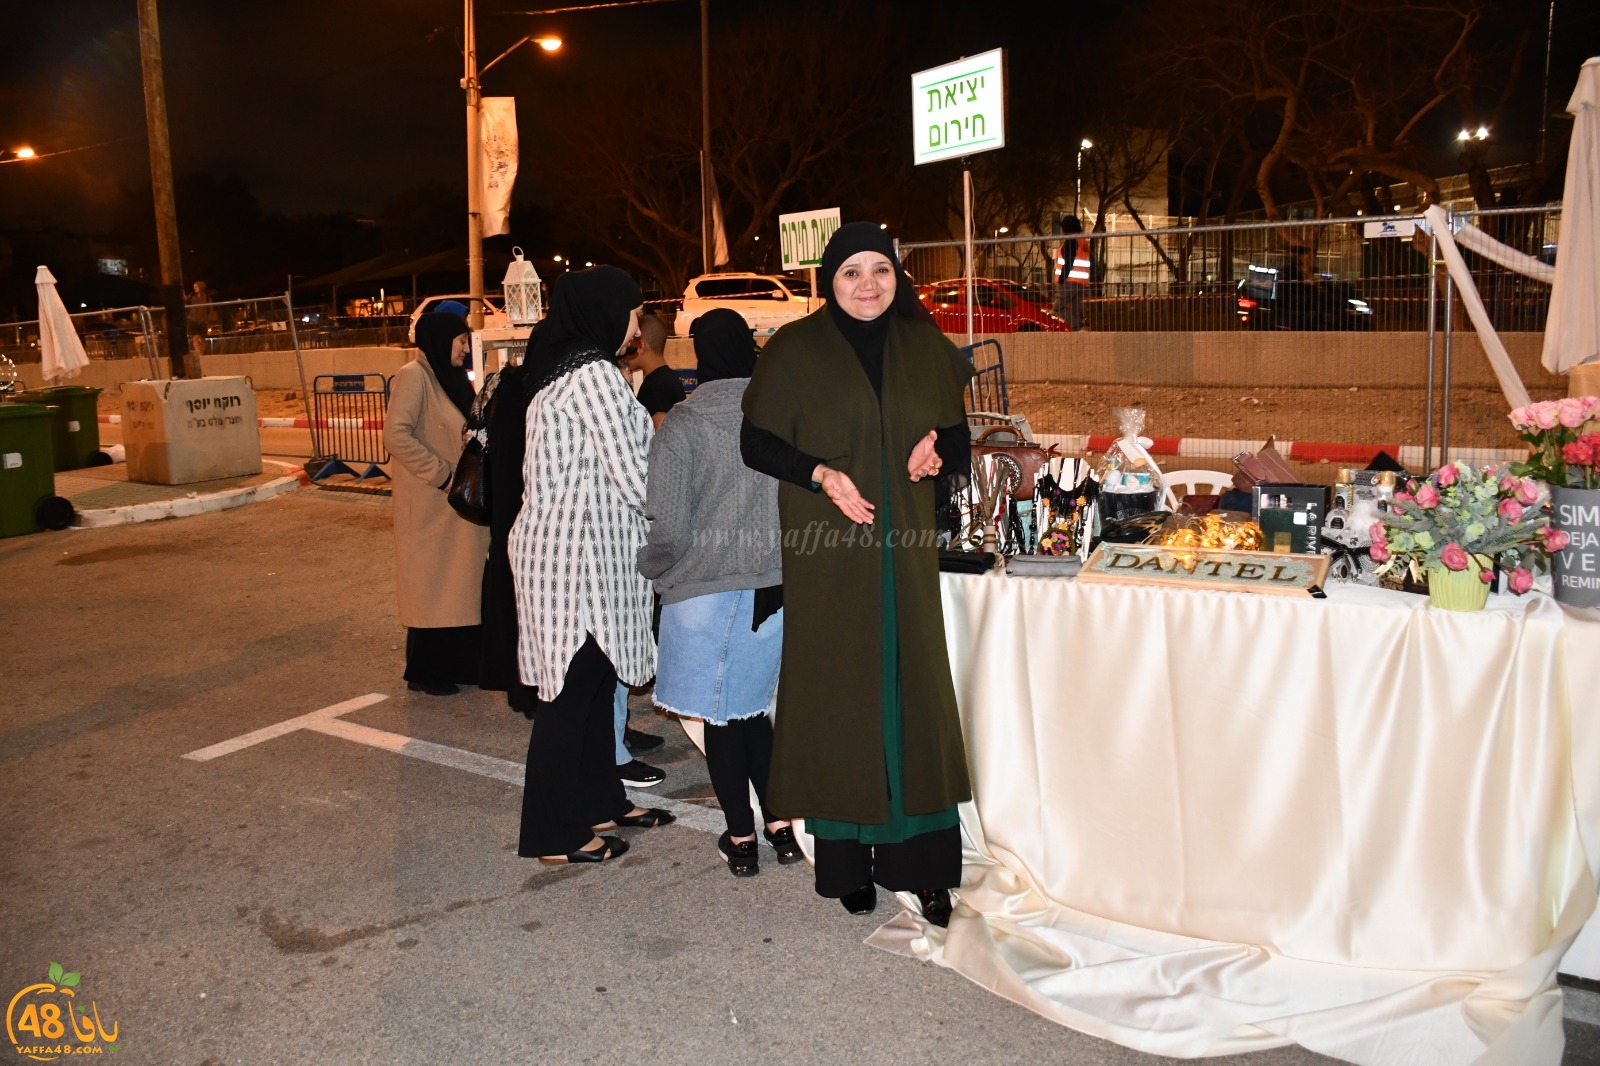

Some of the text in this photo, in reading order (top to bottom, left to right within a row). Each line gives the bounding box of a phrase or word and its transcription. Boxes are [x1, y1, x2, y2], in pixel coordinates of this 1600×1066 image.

[927, 76, 985, 112] יציאת
[929, 114, 985, 147] חירום
[781, 220, 809, 264] חירום
[185, 396, 241, 413] רוקח יוסף
[1306, 503, 1317, 521] LA
[1107, 552, 1298, 582] DANTEL
